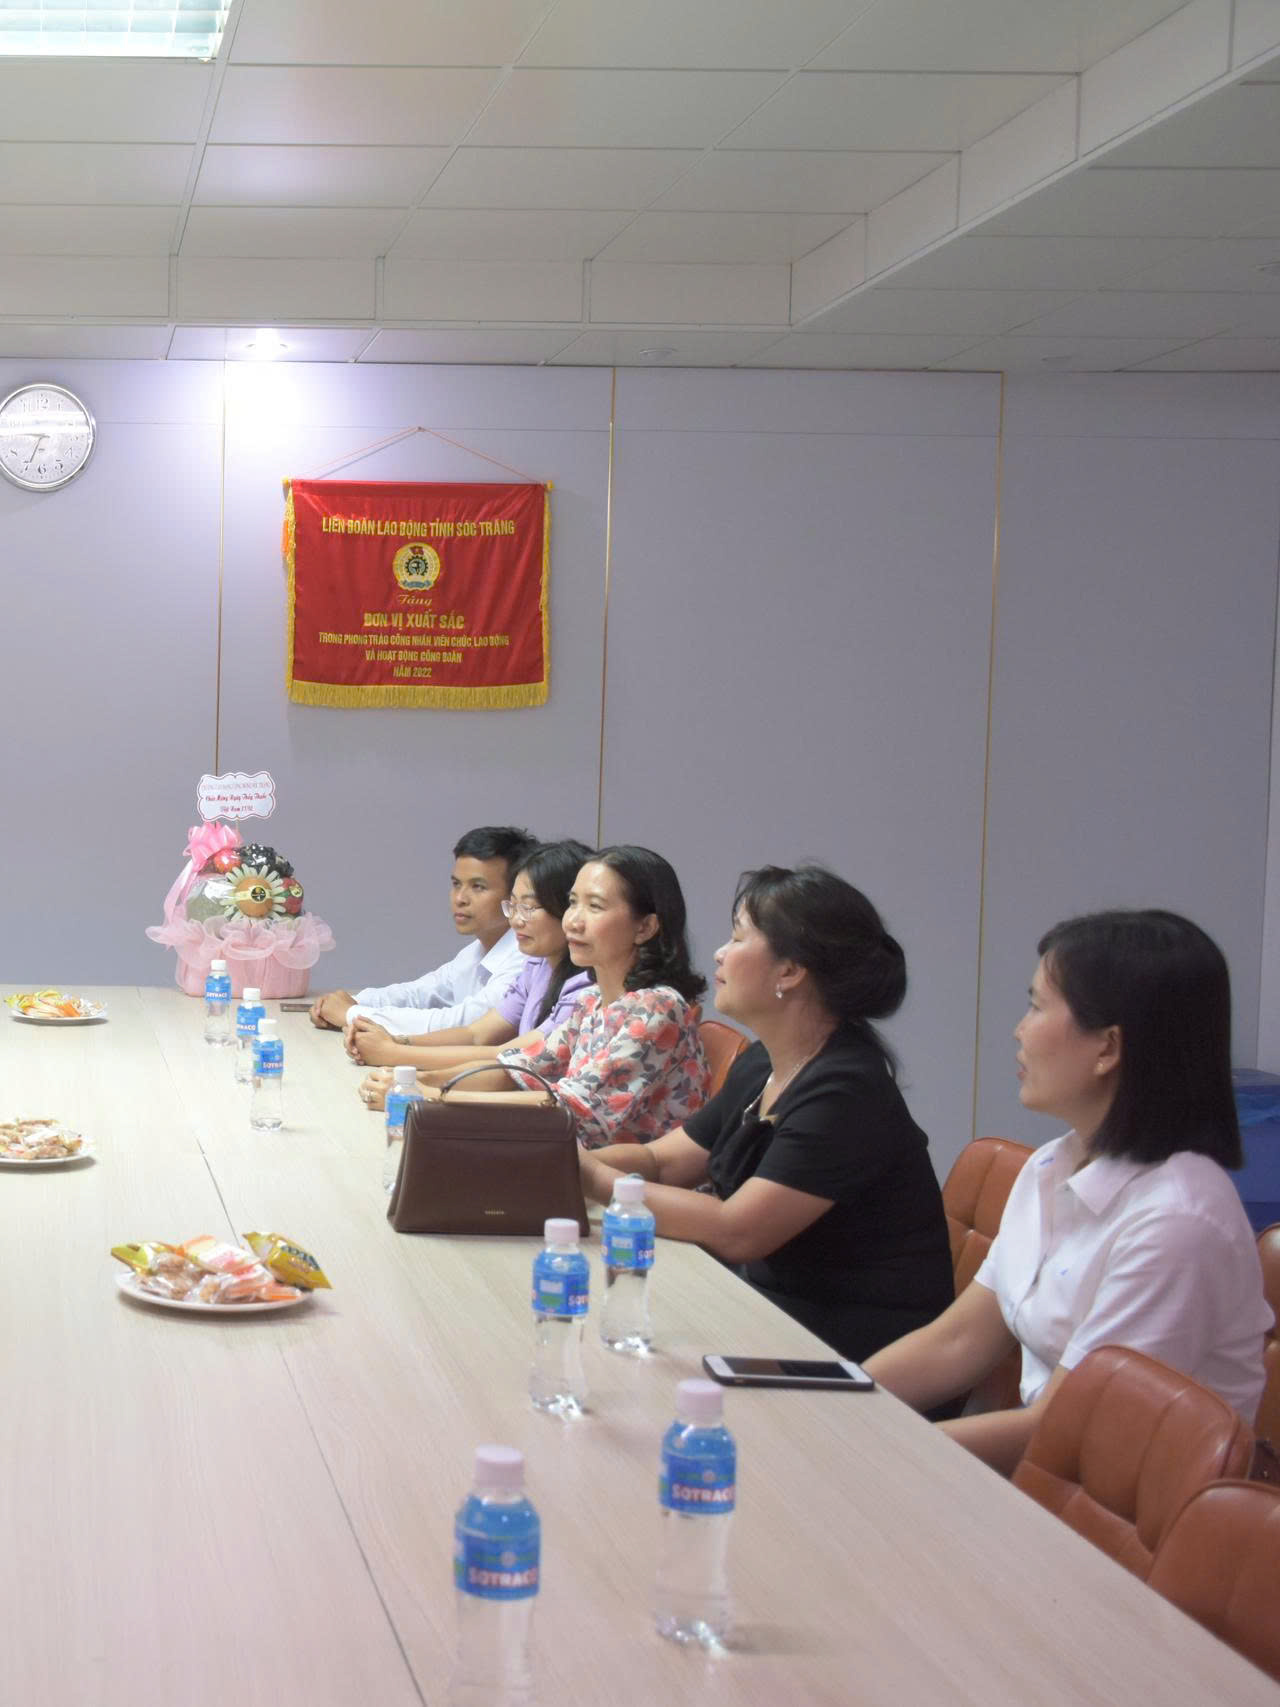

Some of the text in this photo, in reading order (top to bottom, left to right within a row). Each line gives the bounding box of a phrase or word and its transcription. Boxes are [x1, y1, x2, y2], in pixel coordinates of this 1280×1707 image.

[322, 515, 515, 539] LIÊN ĐOÀN LAO ĐỘNG TỈNH SÓC TRĂNG
[363, 608, 464, 630] ĐƠN VỊ XUẤT SẮC
[319, 631, 342, 644] TRONG
[343, 633, 368, 645] PHONG
[368, 633, 389, 645] TRÀO
[390, 633, 410, 646] CÔNG
[433, 634, 450, 646] VIÊN
[474, 636, 488, 647] LAO
[489, 634, 509, 648] ĐỘNG
[365, 648, 462, 663] VÀ HOẠT ĐỘNG CÔNG ĐOÀN
[393, 664, 432, 677] NĂM 2022
